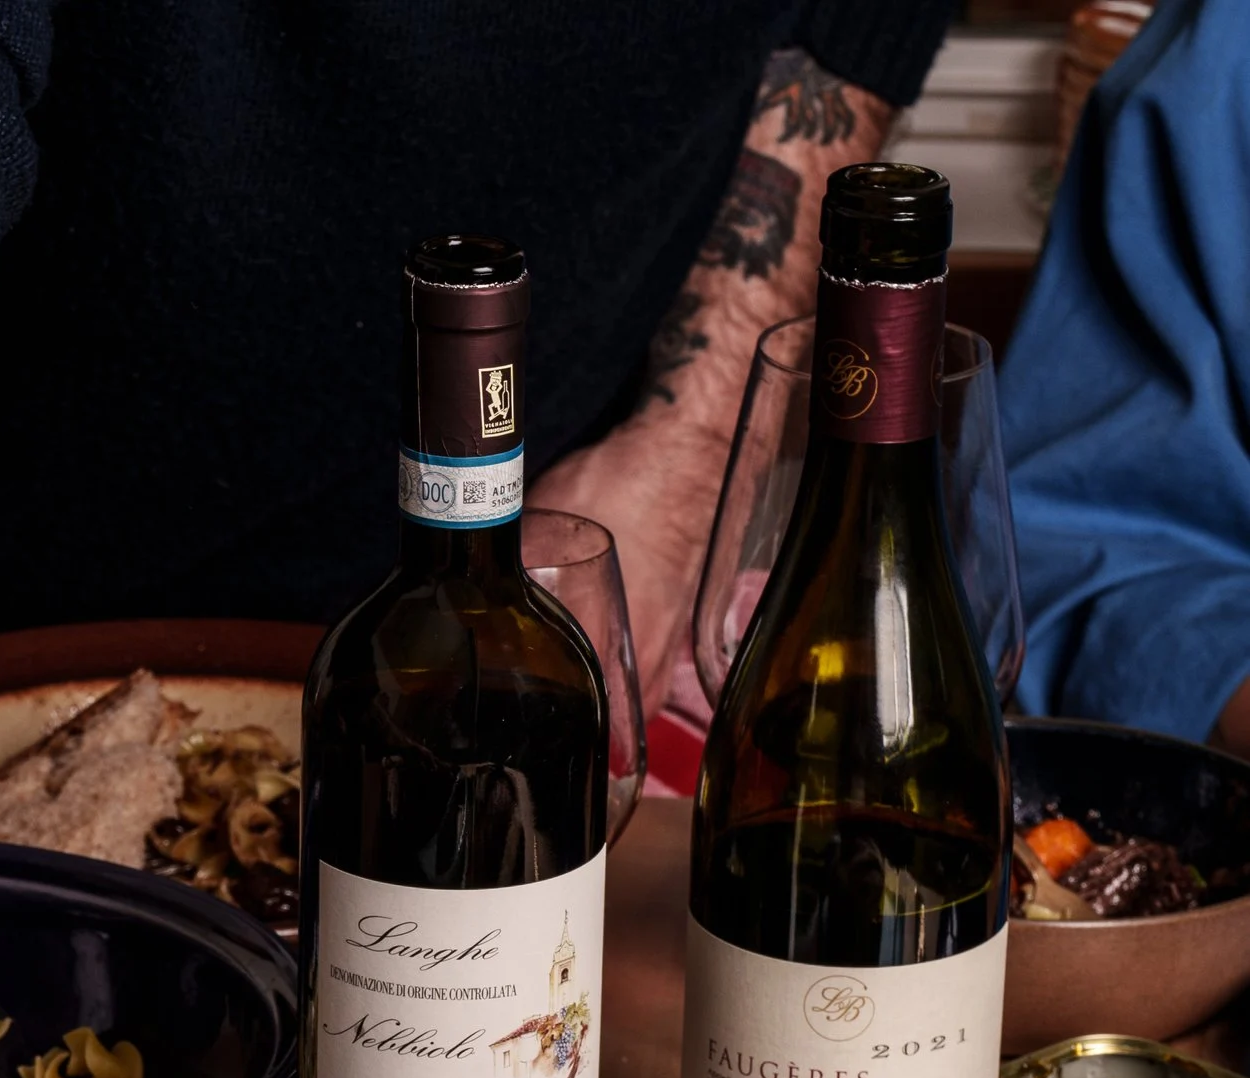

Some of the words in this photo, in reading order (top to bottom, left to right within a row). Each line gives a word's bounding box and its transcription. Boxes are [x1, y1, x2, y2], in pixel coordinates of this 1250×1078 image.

[422, 481, 450, 504] DOC
[345, 915, 502, 971] Langhe
[330, 964, 395, 997] DENOMINAZIONE
[396, 983, 406, 997] DI
[407, 985, 448, 1000] ORIGINE
[449, 984, 517, 1000] CONTROLLATA
[323, 1014, 486, 1060] Nebbiolo
[871, 1027, 966, 1059] 2021
